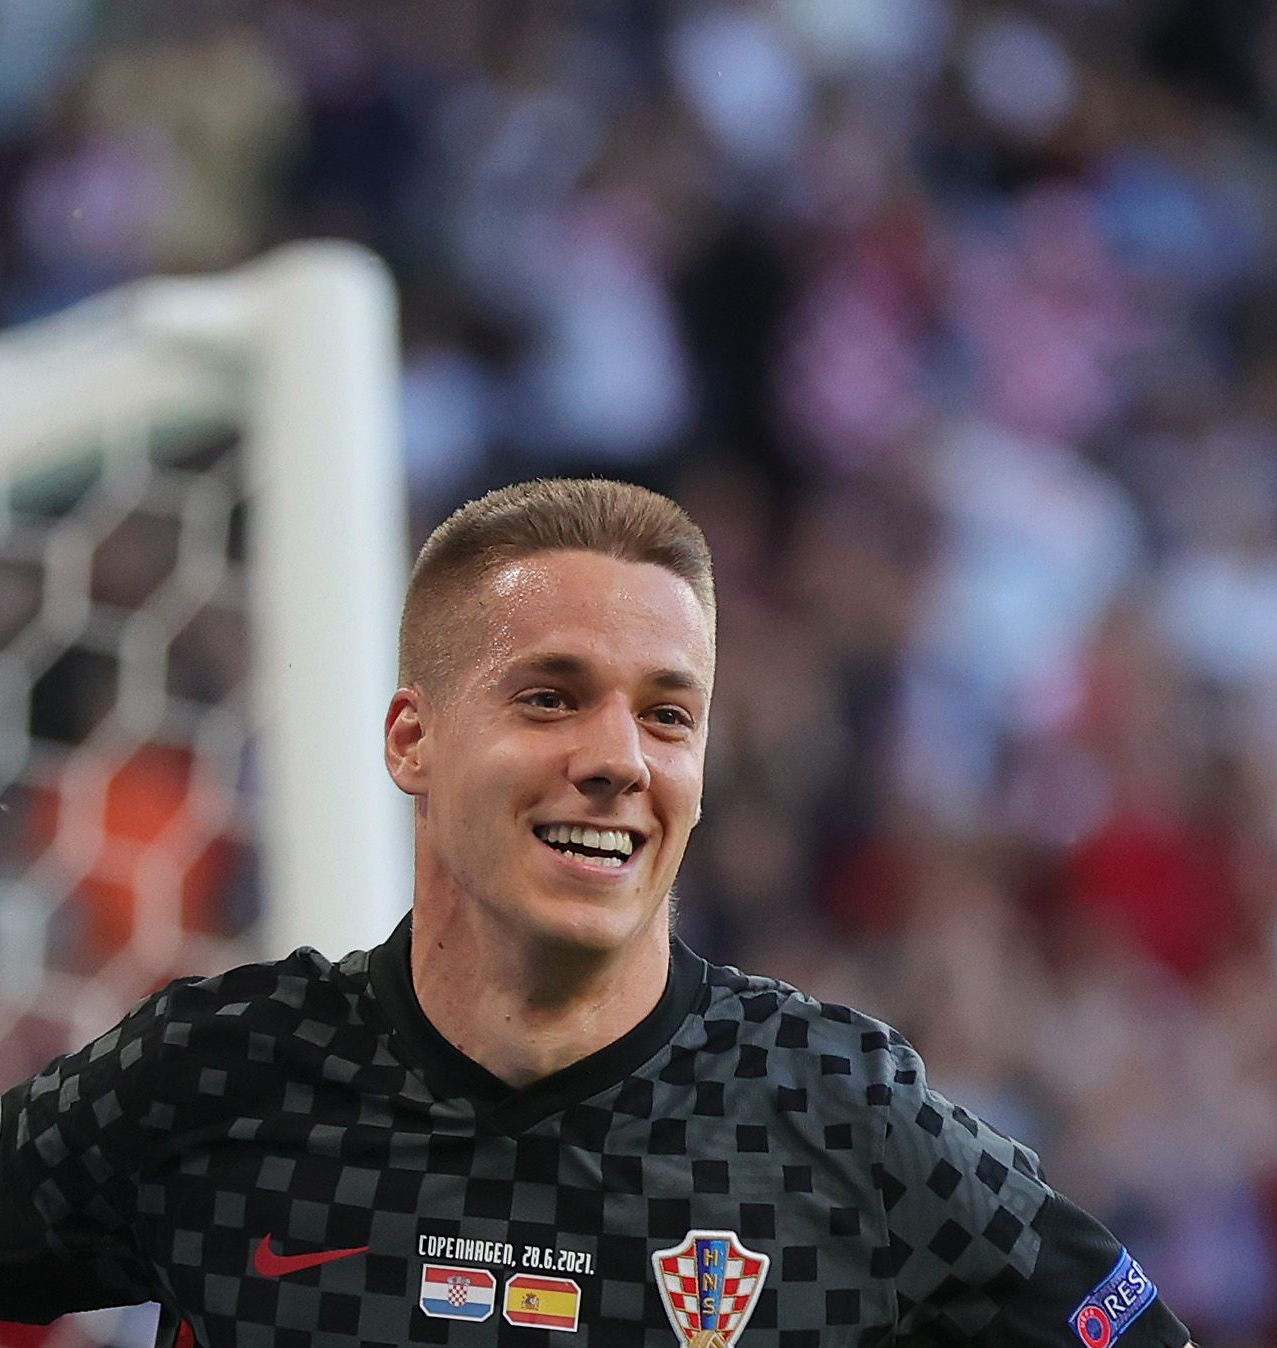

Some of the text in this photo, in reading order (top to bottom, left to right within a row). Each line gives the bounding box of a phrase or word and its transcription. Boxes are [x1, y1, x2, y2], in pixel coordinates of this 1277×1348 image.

[418, 1234, 595, 1275] COPENHAGEN, 28.6.2021.
[703, 1248, 718, 1315] HNS
